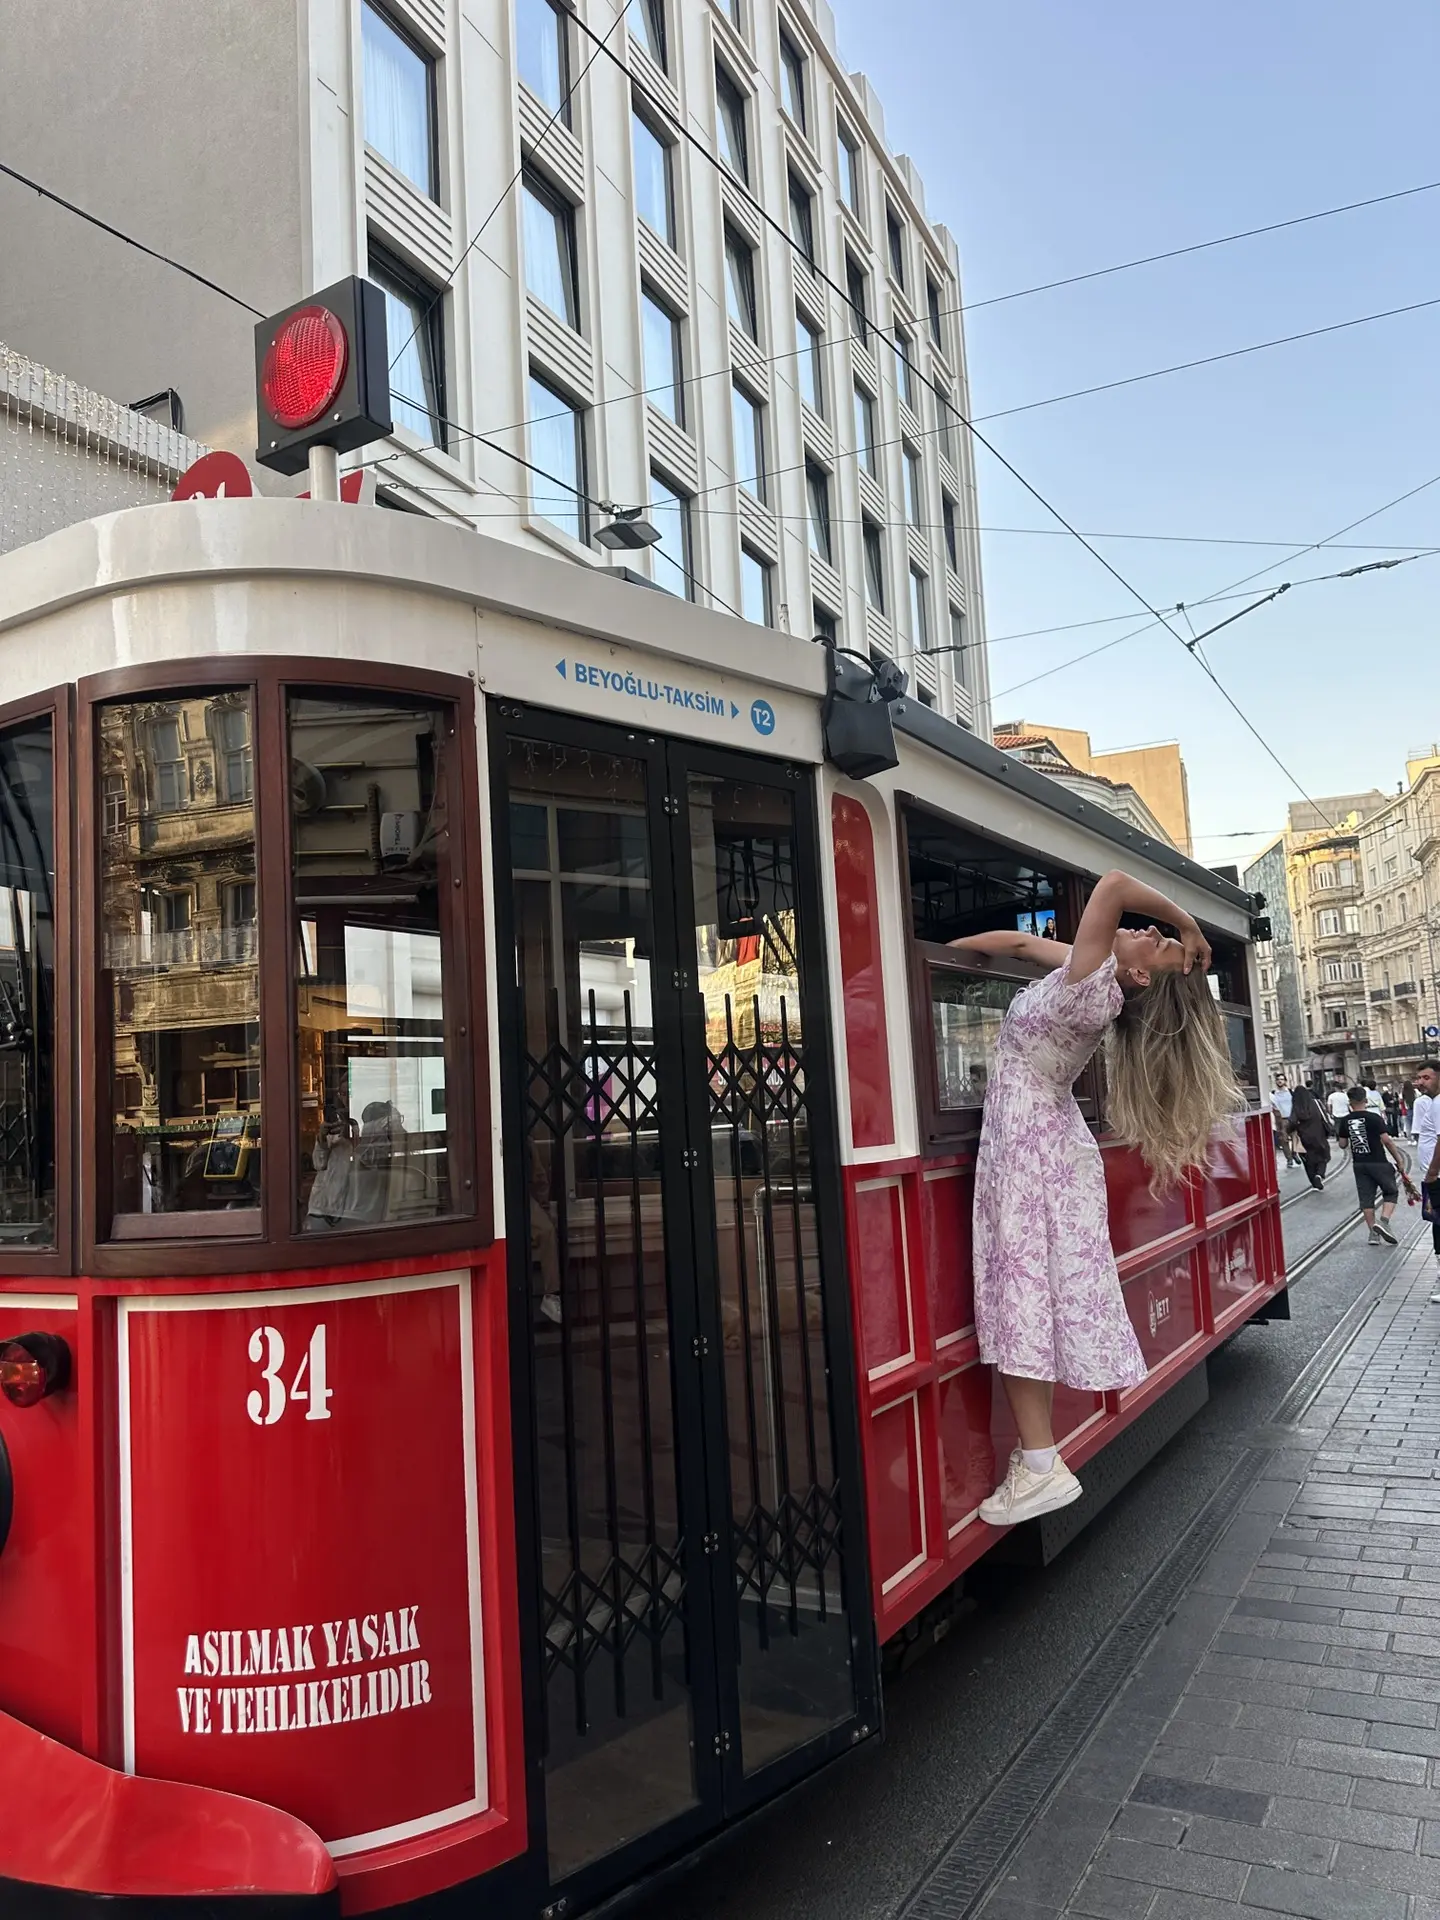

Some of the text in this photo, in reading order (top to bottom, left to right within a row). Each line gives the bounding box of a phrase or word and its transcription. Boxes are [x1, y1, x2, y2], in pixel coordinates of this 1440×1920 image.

[574, 662, 771, 727] BEYOĞLU-TAKSİM T2
[247, 1324, 334, 1425] 34
[184, 1605, 421, 1677] ASILMAK YASAK
[177, 1659, 433, 1734] VE TEHLIKELIDIR
